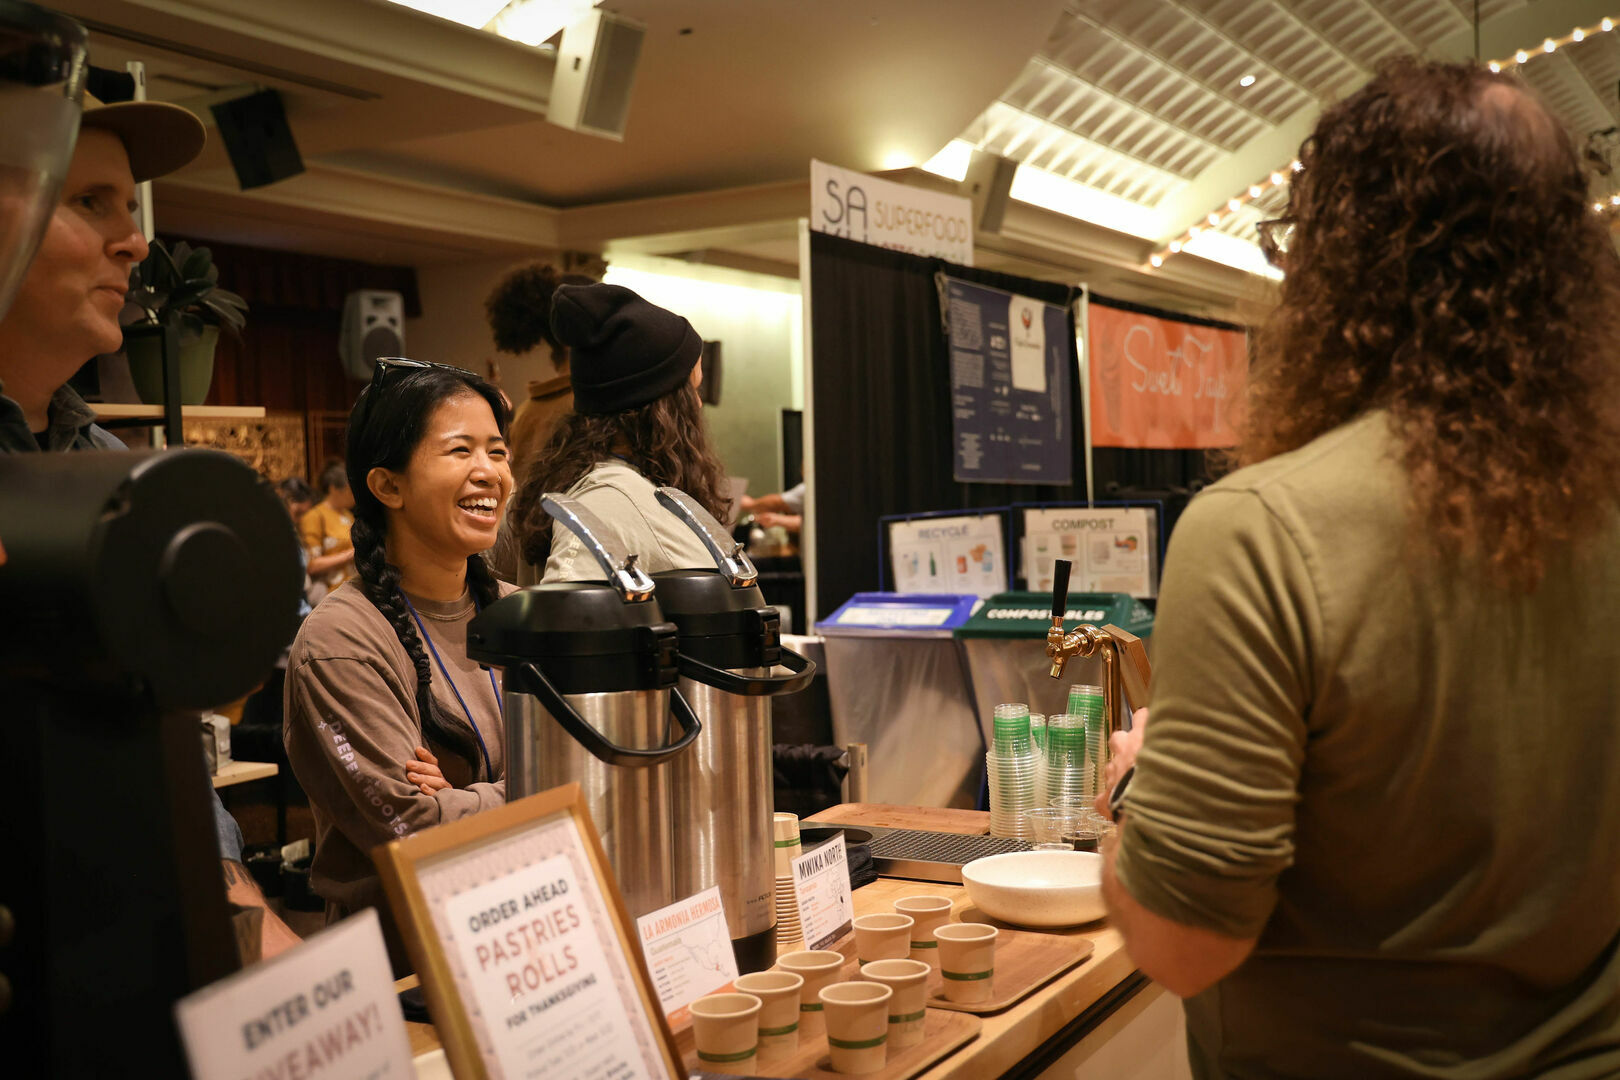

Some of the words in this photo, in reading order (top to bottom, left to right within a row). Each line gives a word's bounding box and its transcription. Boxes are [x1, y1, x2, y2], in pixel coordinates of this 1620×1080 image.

[822, 179, 868, 230] SA
[873, 200, 969, 244] SUPERFOOD
[918, 524, 970, 539] RECYCLE
[1052, 518, 1115, 531] COMPOST
[986, 608, 1106, 621] COMPOSBLES
[362, 786, 409, 835] ROOTS
[798, 853, 824, 880] MWIKA
[469, 902, 519, 934] ORDER
[523, 878, 569, 911] AHEAD
[643, 923, 655, 941] LA
[653, 908, 690, 938] ARMONIA
[690, 895, 721, 922] HERMOSA
[475, 903, 581, 972] PASTRIES
[506, 945, 579, 1000] ROLLS
[242, 993, 310, 1051] ENTER
[312, 967, 355, 1009] OUR
[506, 1005, 529, 1029] FOR
[529, 973, 597, 1016] THANKSGIVING
[247, 1001, 384, 1080] VEAWAY!
